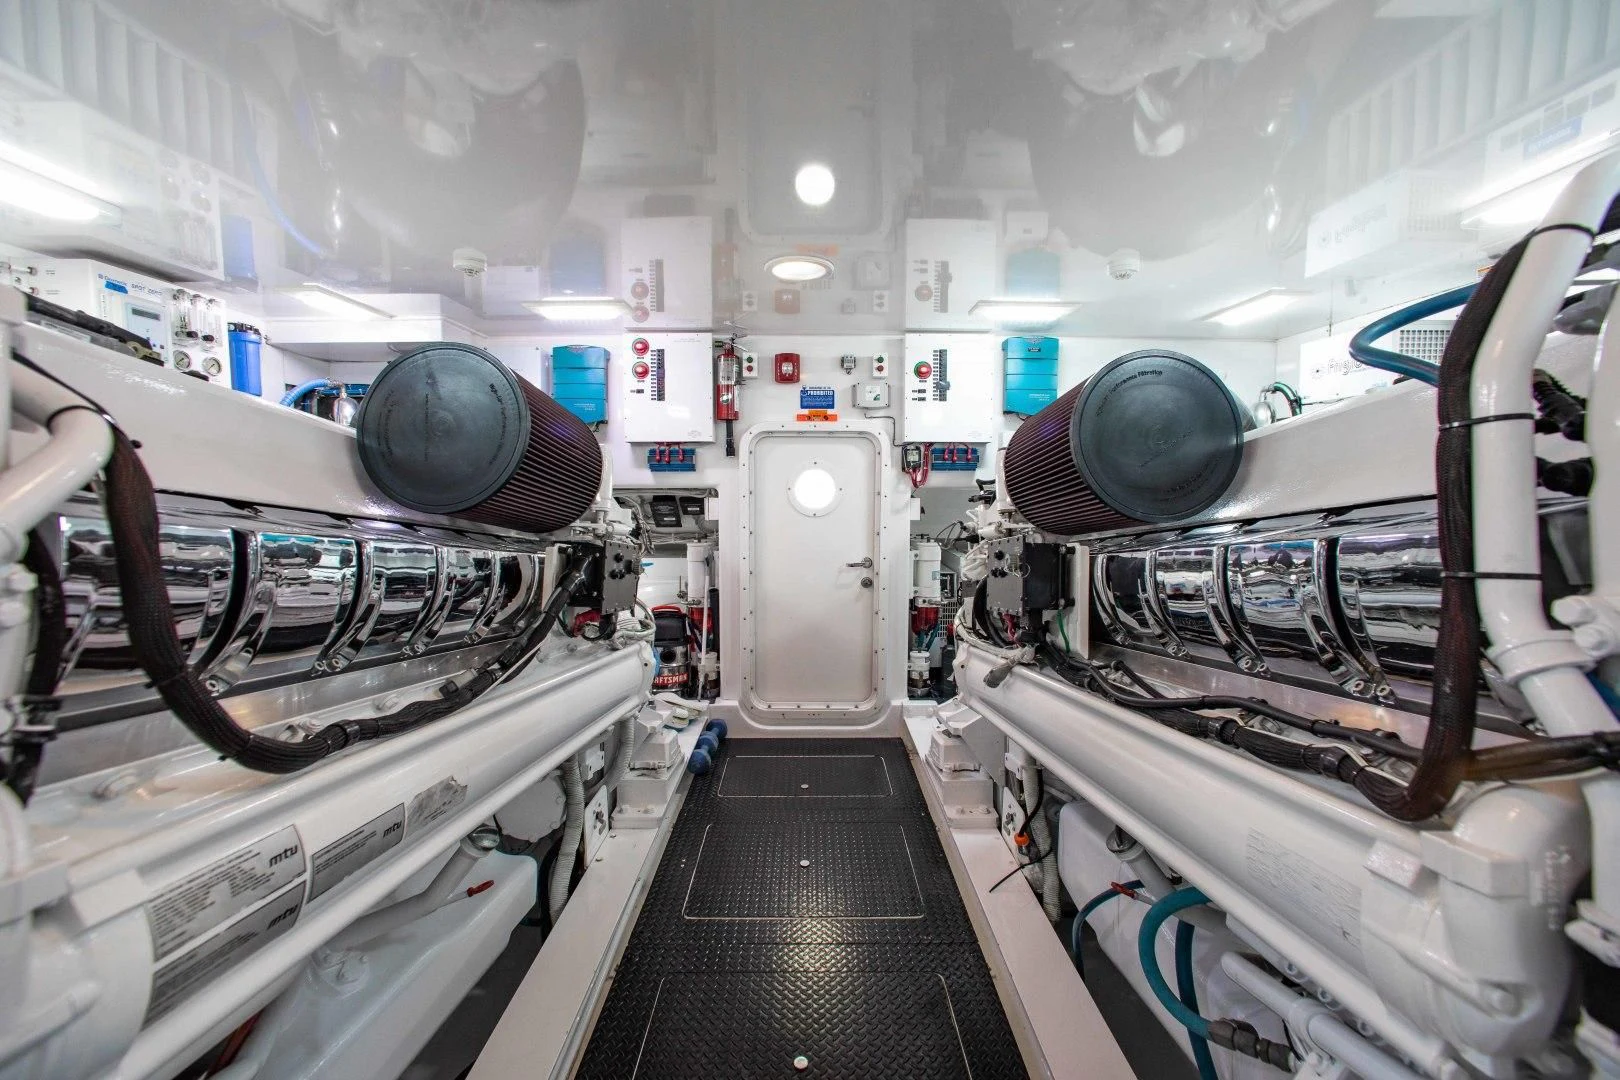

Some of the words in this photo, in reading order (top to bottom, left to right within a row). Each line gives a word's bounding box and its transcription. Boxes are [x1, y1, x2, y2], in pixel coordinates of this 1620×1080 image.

[655, 674, 687, 684] AFTSMAN
[383, 820, 402, 838] mtu
[269, 844, 298, 868] mtu
[266, 904, 298, 931] mtu
